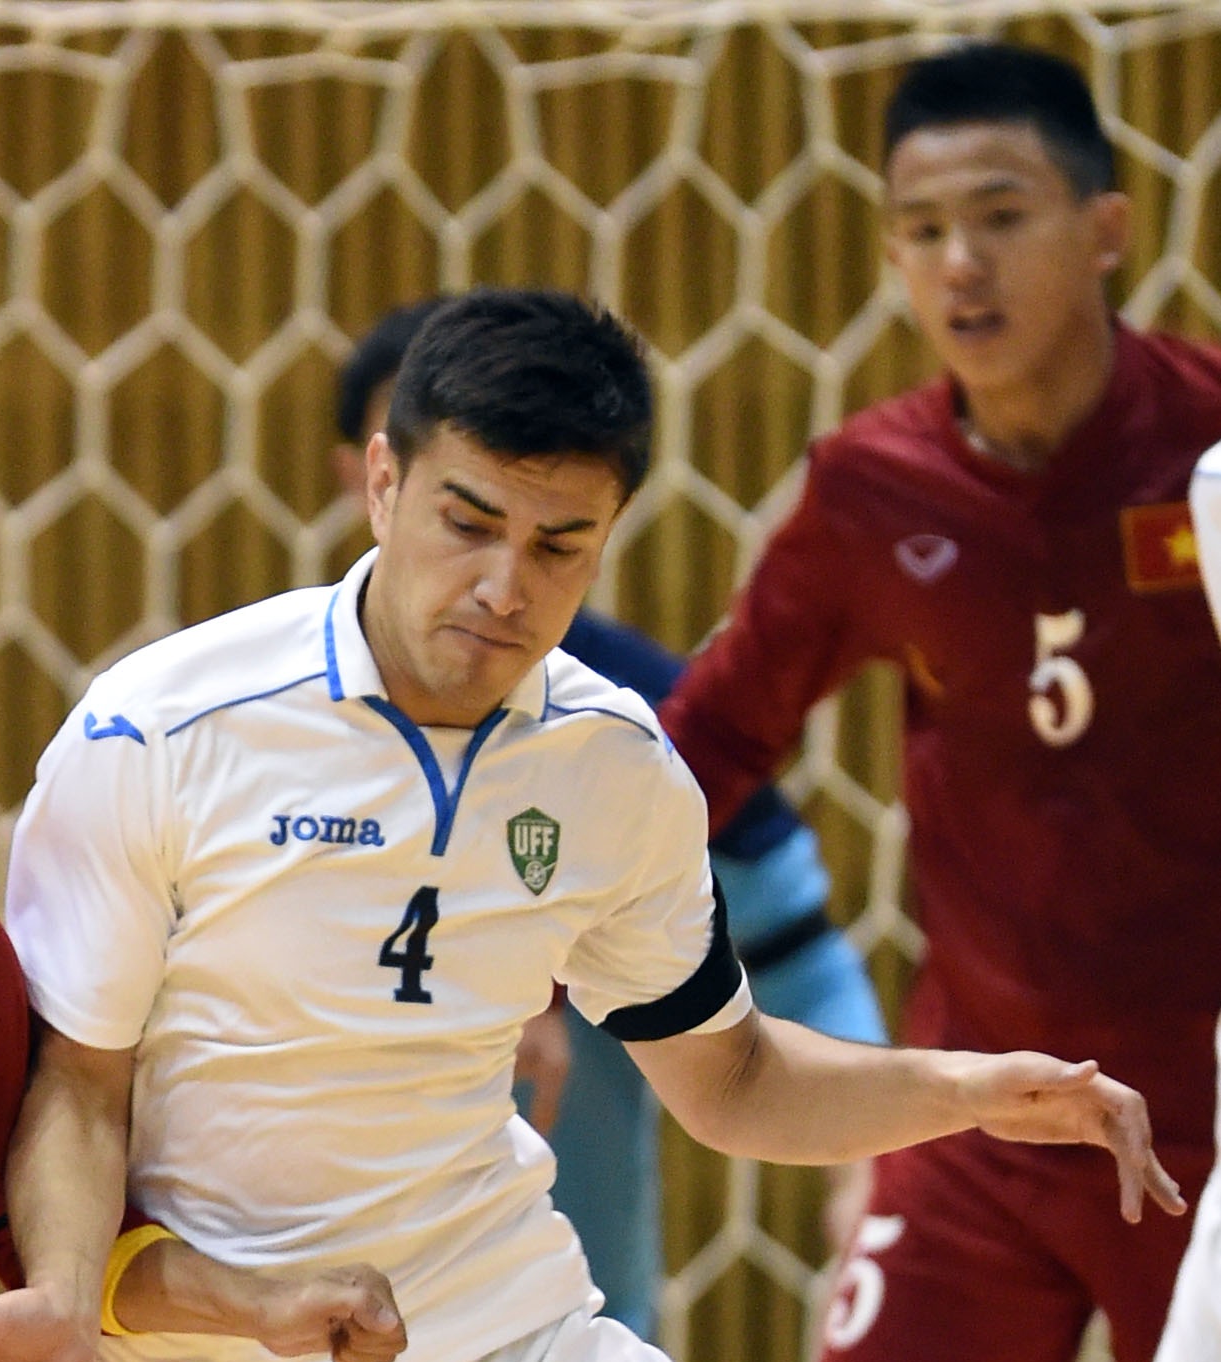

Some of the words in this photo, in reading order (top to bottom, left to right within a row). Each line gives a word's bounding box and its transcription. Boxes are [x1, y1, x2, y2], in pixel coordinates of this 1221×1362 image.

[1028, 607, 1094, 747] 5
[514, 824, 555, 856] UFF
[379, 885, 440, 1004] 4
[827, 1214, 906, 1349] 5
